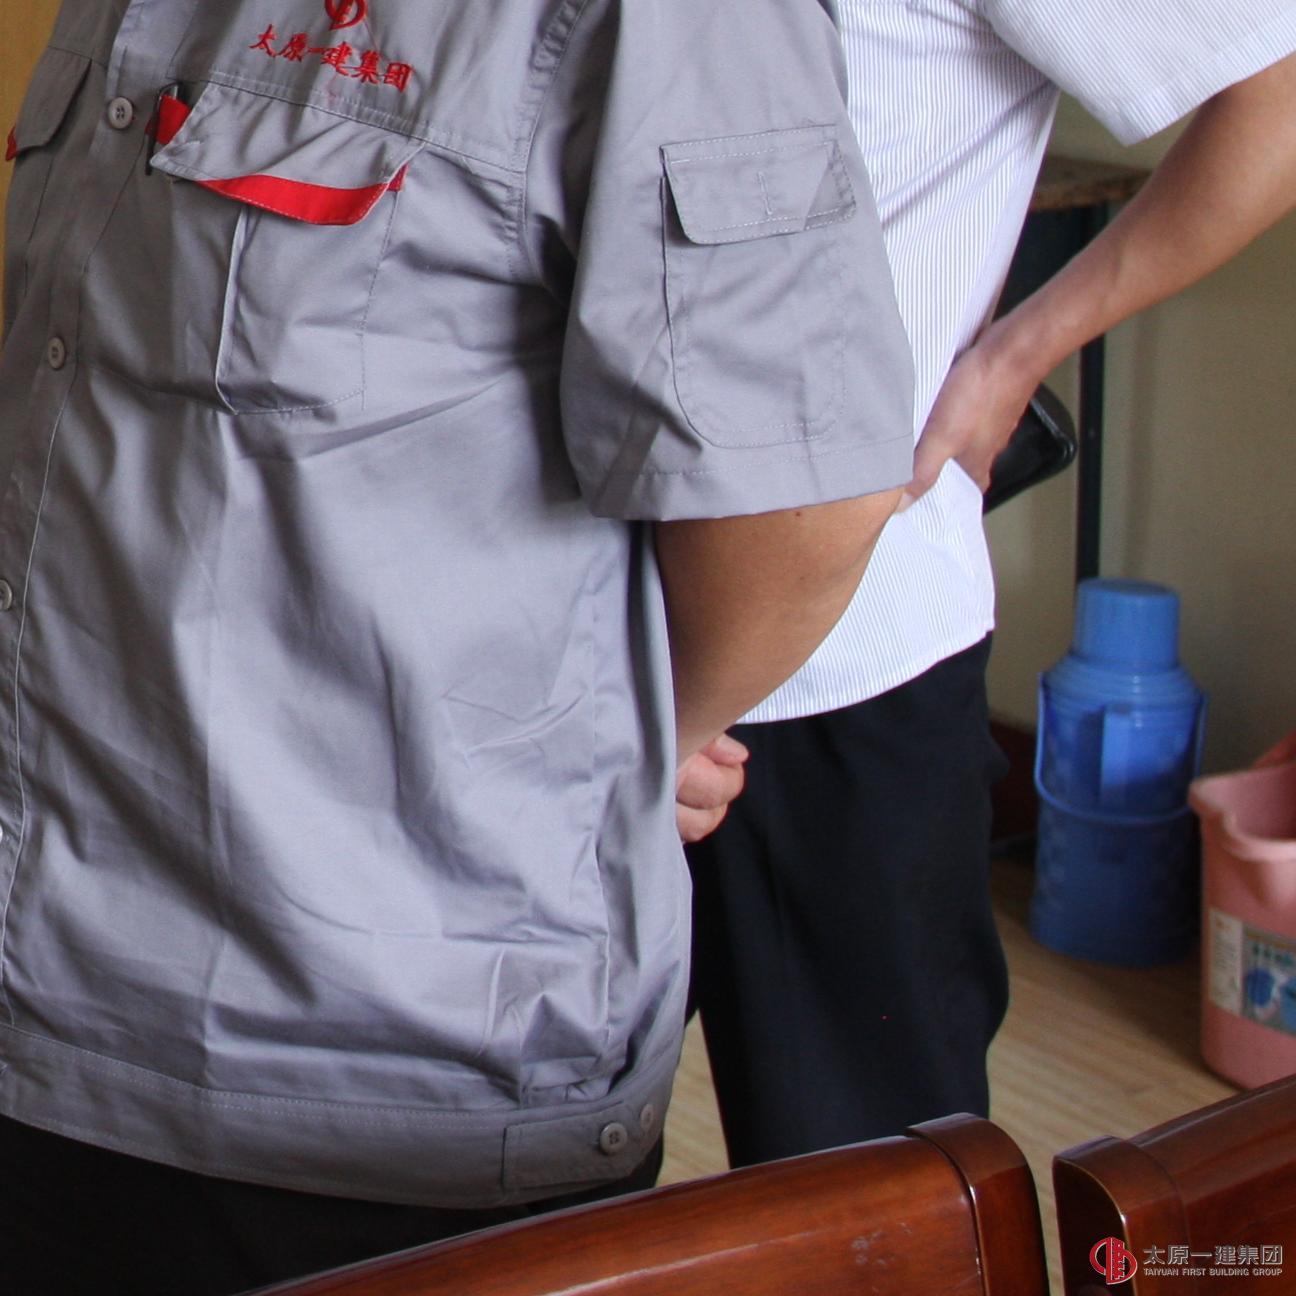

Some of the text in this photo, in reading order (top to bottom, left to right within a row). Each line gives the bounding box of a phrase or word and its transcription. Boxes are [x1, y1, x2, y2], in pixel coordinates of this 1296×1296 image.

[249, 23, 416, 94] 太原一建集团
